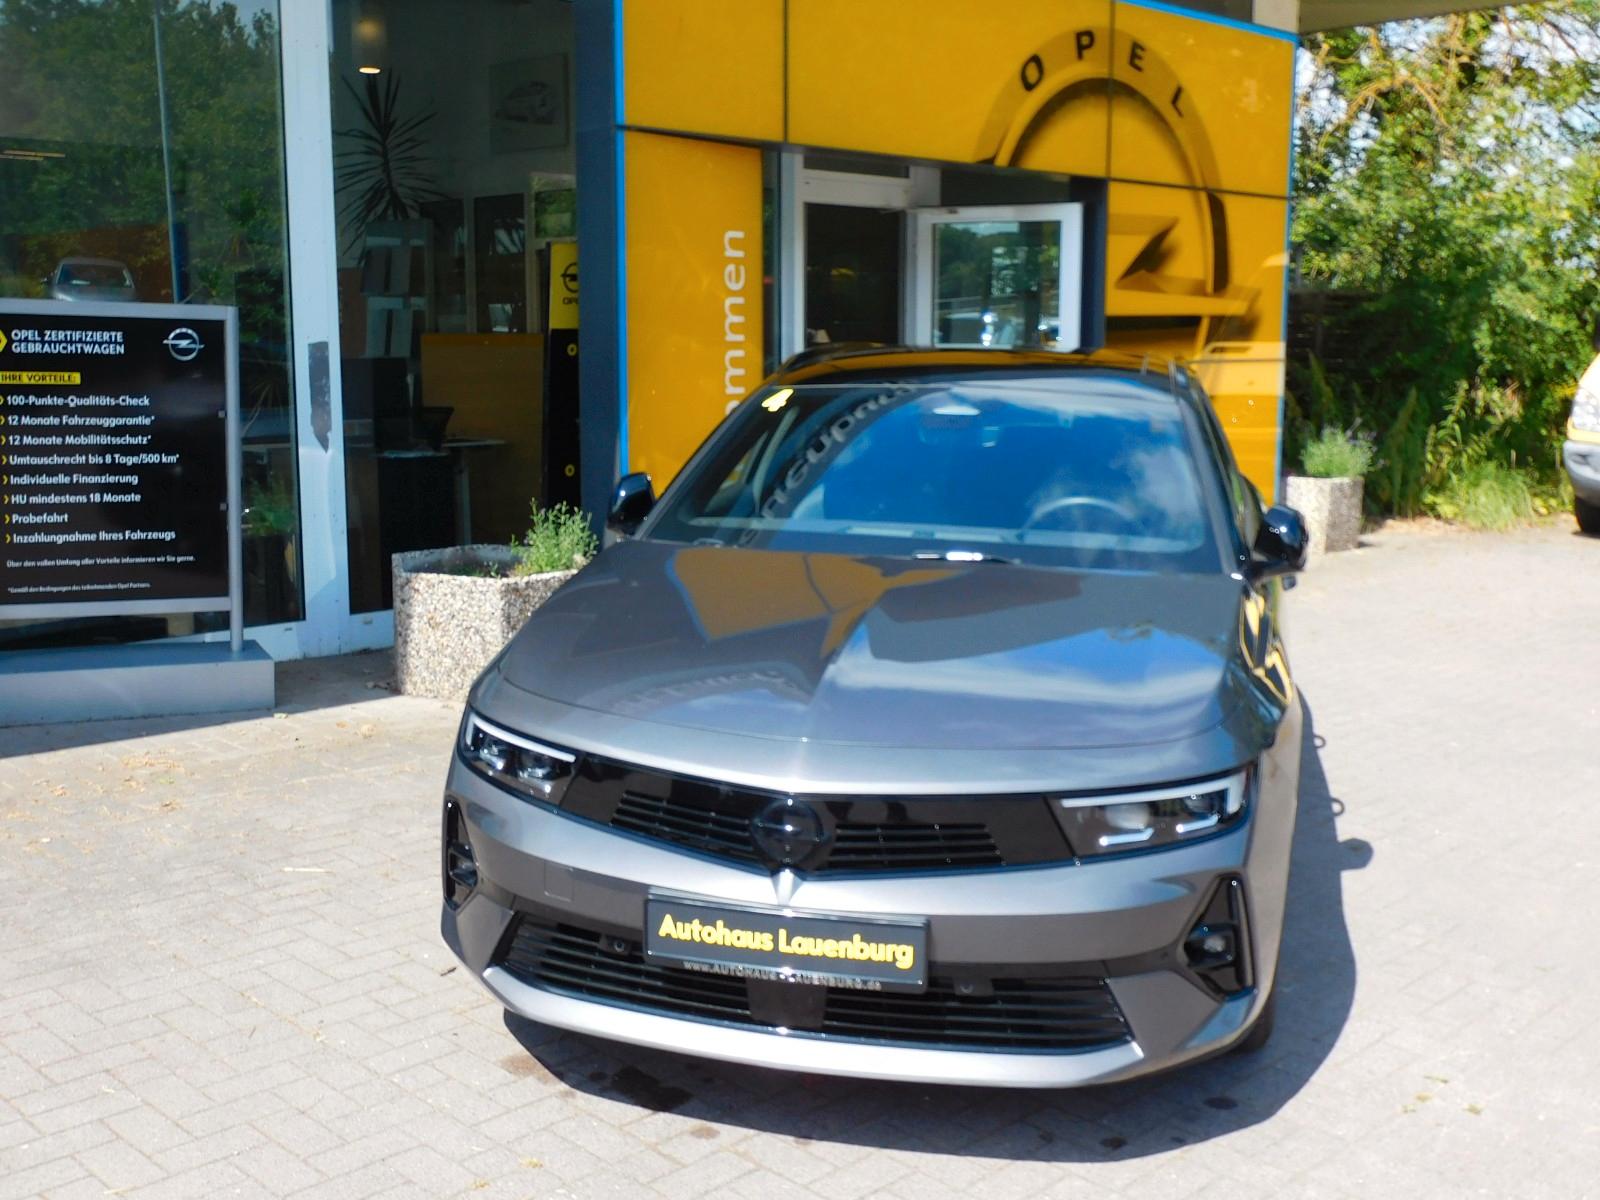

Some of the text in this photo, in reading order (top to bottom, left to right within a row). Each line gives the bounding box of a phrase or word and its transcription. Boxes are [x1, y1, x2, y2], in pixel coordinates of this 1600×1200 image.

[1020, 29, 1184, 118] OPEL
[11, 329, 124, 343] OPEL ZERTIFIZIERTE
[12, 342, 125, 355] GEBRAUCHTWAGEN
[1, 374, 76, 383] IHRE VORTEILE:
[7, 395, 150, 408] 100-Punkte-Qualitäts-Check
[8, 415, 19, 426] 12
[20, 415, 61, 426] Monate
[9, 435, 21, 446] 12
[23, 435, 63, 446] Monate
[9, 454, 86, 465] Umtauschrecht
[88, 454, 103, 465] bis
[105, 454, 112, 464] 8
[113, 454, 160, 466] Tage/500
[10, 473, 139, 486] Individuelle Finanzierung
[11, 492, 141, 505] HU mindestens 18 Monate
[12, 513, 68, 525] Probefahrt
[13, 530, 176, 545] Inzahlungnahme Ihres Fahrzeugs
[658, 913, 914, 970] Autohaus Lauenburg
